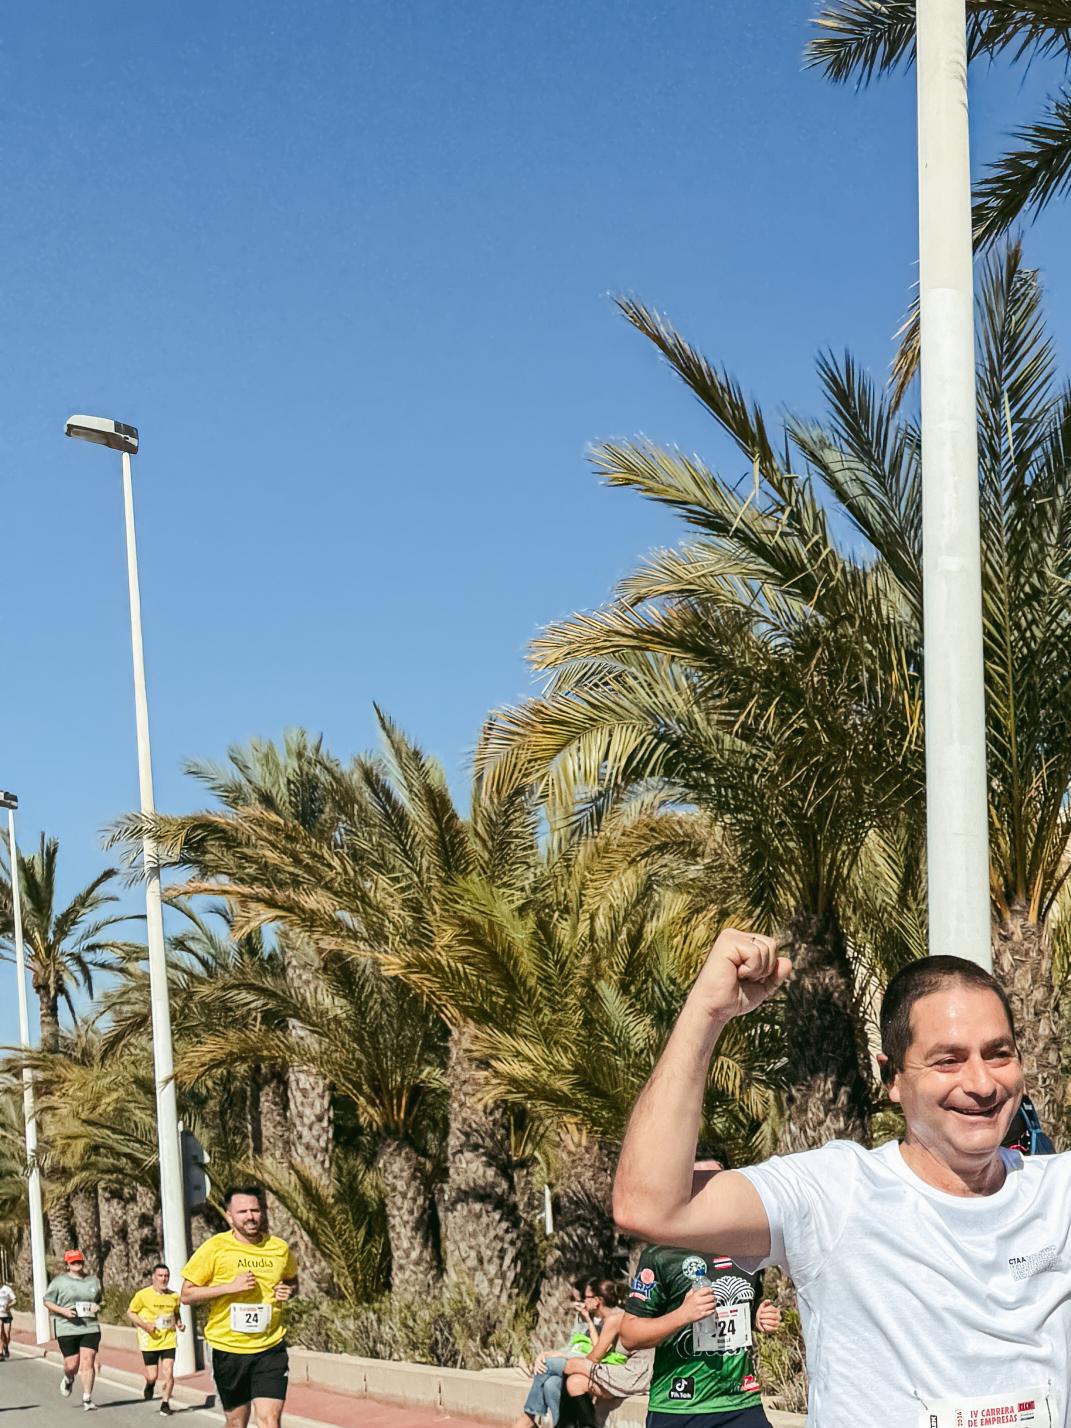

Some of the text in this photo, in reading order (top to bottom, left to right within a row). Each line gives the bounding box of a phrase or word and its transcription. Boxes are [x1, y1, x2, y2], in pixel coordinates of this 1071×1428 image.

[237, 1258, 273, 1268] Alcudia
[245, 1313, 258, 1323] 24
[970, 1406, 1015, 1418] IV CARRERA
[968, 1414, 1018, 1428] DE EMPRESAS
